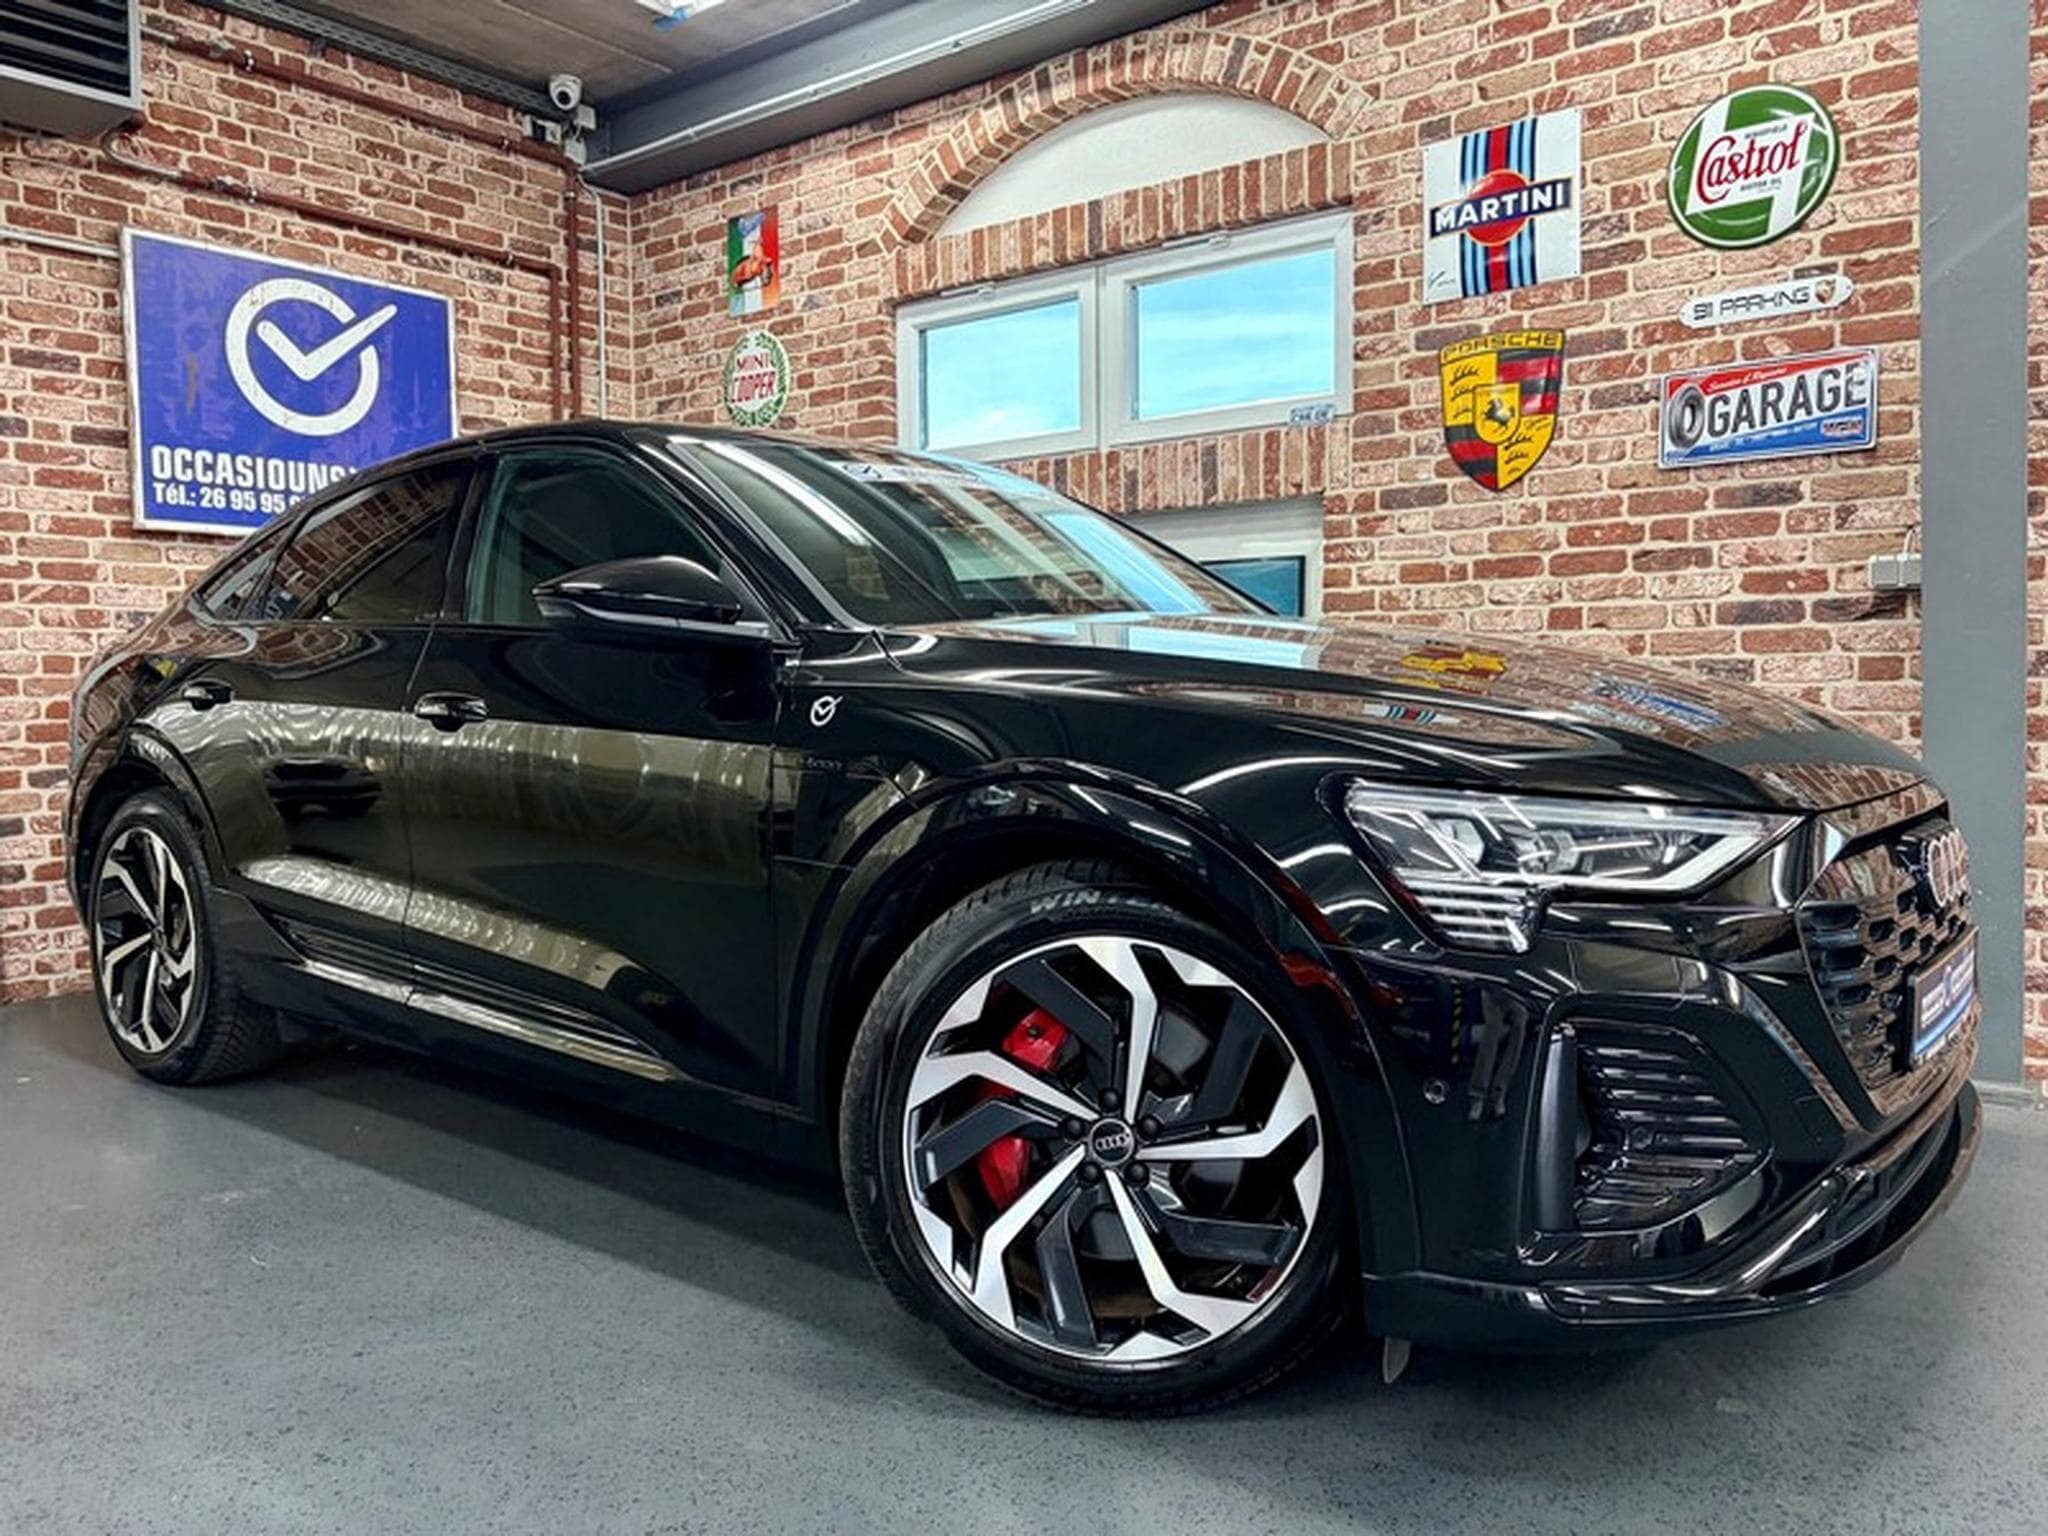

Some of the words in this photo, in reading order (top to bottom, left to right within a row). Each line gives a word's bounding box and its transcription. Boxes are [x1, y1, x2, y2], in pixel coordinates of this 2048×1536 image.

[1696, 119, 1808, 205] Castrol
[1435, 182, 1563, 232] MARTINI
[735, 352, 770, 371] MINI
[1443, 335, 1559, 360] PORSCHE
[731, 370, 776, 403] COOPER
[1707, 361, 1868, 438] GARAGE
[150, 444, 358, 494] OCCASIOUNS
[199, 486, 227, 509] 26
[230, 490, 257, 513] 95
[260, 493, 286, 514] 95
